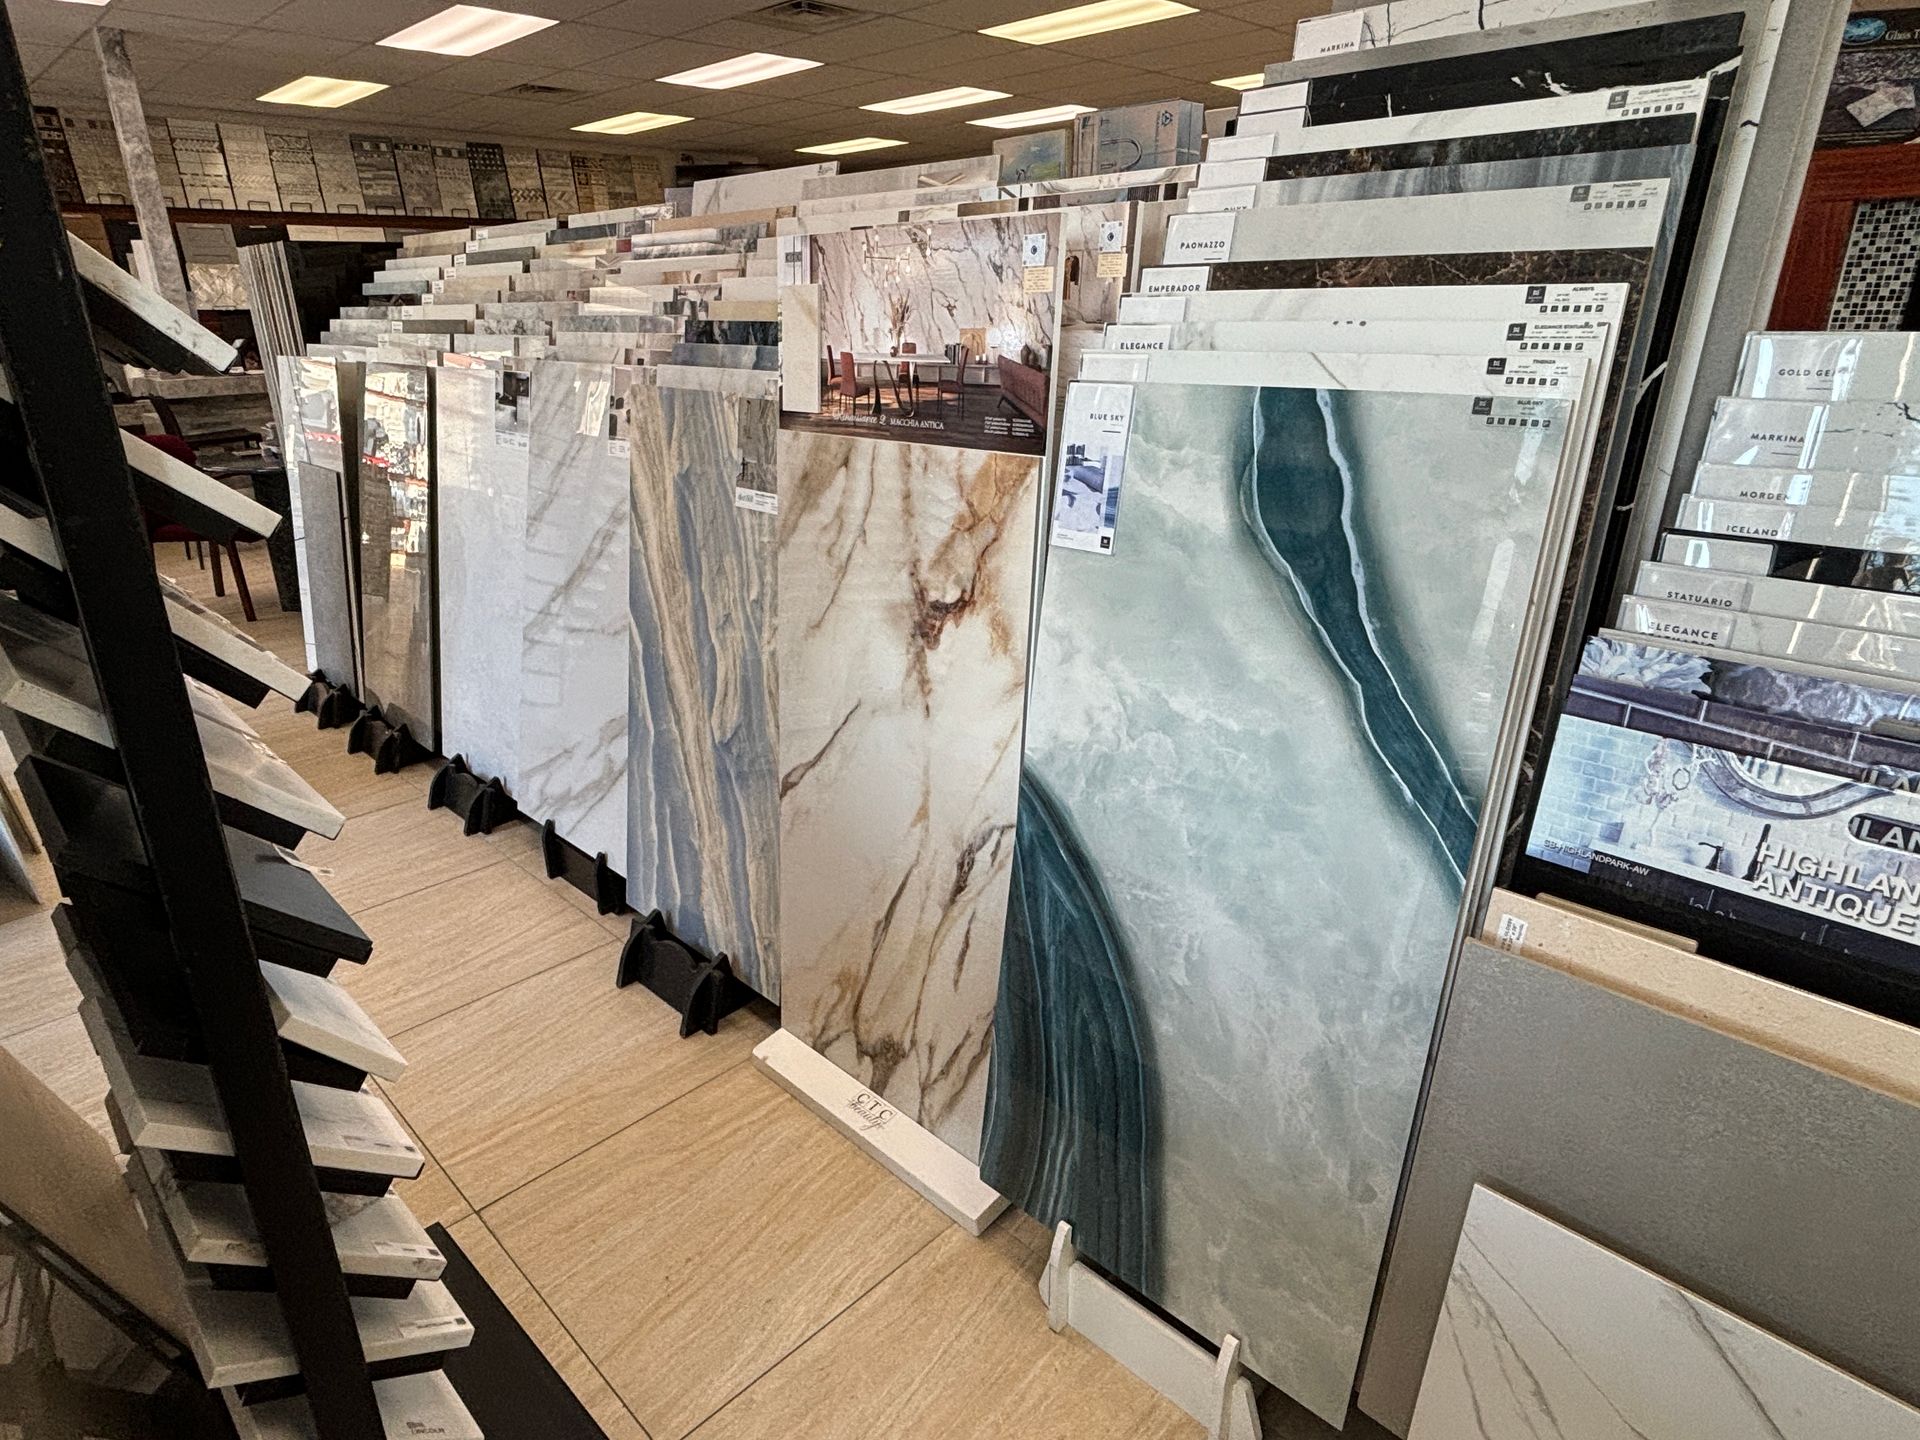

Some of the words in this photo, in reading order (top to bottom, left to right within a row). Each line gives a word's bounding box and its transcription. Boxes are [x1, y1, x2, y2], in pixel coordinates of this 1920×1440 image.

[1320, 41, 1355, 53] MARKINA
[1180, 240, 1225, 249] PAONAZZO
[1148, 284, 1201, 293] EMPERADOR
[1120, 342, 1164, 350] ELEGANCE
[1778, 368, 1811, 377] GOLD
[1090, 413, 1108, 421] BLUE
[1110, 414, 1124, 422] SKY
[1750, 433, 1805, 443] MARKINA
[1726, 524, 1778, 537] ICELAND
[1667, 591, 1733, 607] STATUARIO
[1543, 839, 1650, 876] SB-HIGHLANDPARK-AW
[857, 1093, 894, 1121] CTC
